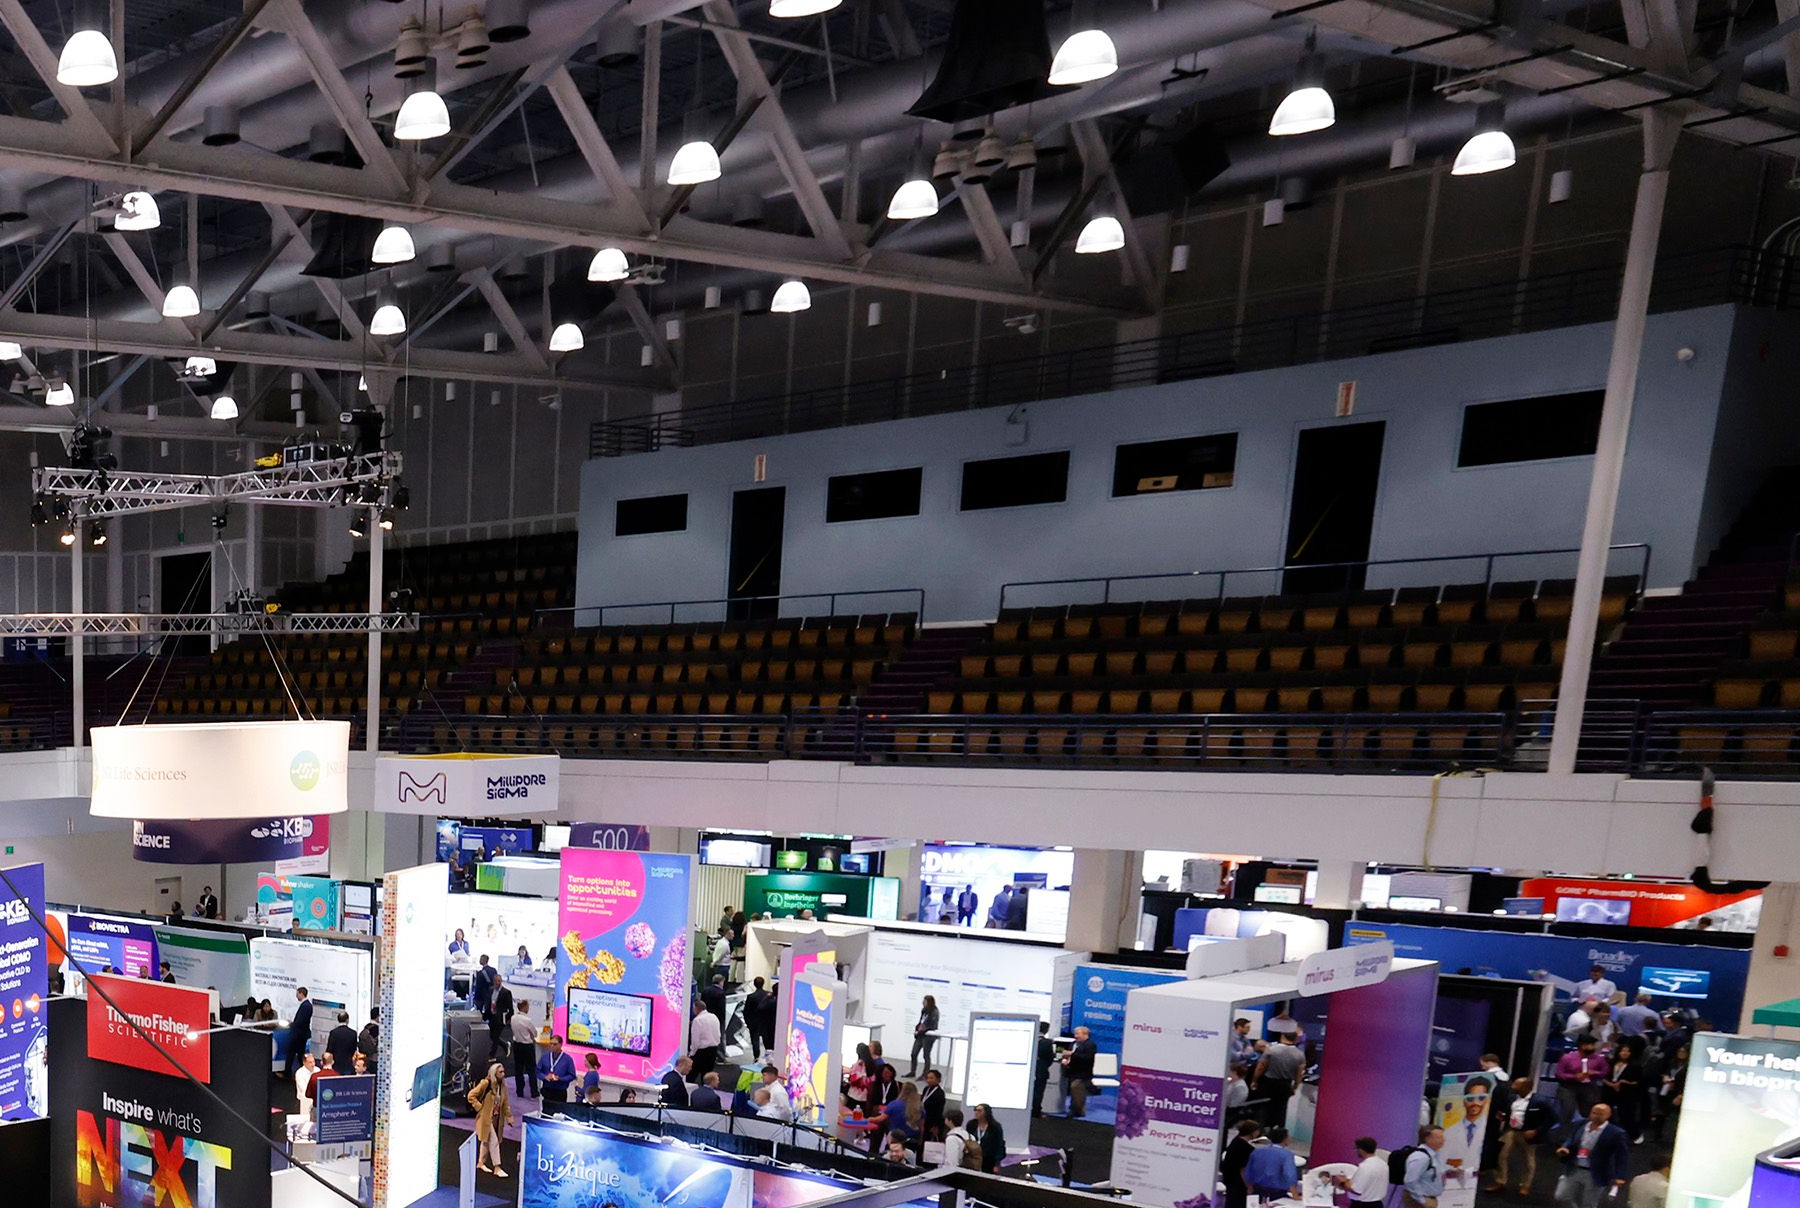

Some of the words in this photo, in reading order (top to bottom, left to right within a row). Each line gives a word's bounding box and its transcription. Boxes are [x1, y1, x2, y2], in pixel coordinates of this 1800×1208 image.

[134, 767, 187, 781] Sciences
[283, 818, 303, 837] KB
[134, 834, 171, 849] SCIENCE
[592, 827, 629, 850] 500
[568, 875, 585, 883] Turn
[586, 878, 614, 886] options
[567, 884, 637, 898] opportunities
[1639, 891, 1686, 901] Products
[96, 922, 130, 934] BIOVECTRA
[11, 950, 31, 966] CDMO
[1588, 949, 1640, 964] Broadley
[1304, 967, 1335, 985] mirus
[1, 979, 21, 992] Solutions
[1085, 999, 1121, 1011] Custom
[1084, 1011, 1113, 1021] resins
[152, 1013, 189, 1036] Fisher
[1132, 1023, 1163, 1034] mirus
[108, 1023, 188, 1048] SCIETIFIC
[1706, 1046, 1763, 1067] Your
[1764, 1053, 1800, 1072] he
[1703, 1066, 1727, 1083] in
[1182, 1087, 1218, 1102] Titer
[102, 1092, 154, 1122] Inspire
[157, 1108, 202, 1134] what's
[1144, 1095, 1217, 1116] Enhancer
